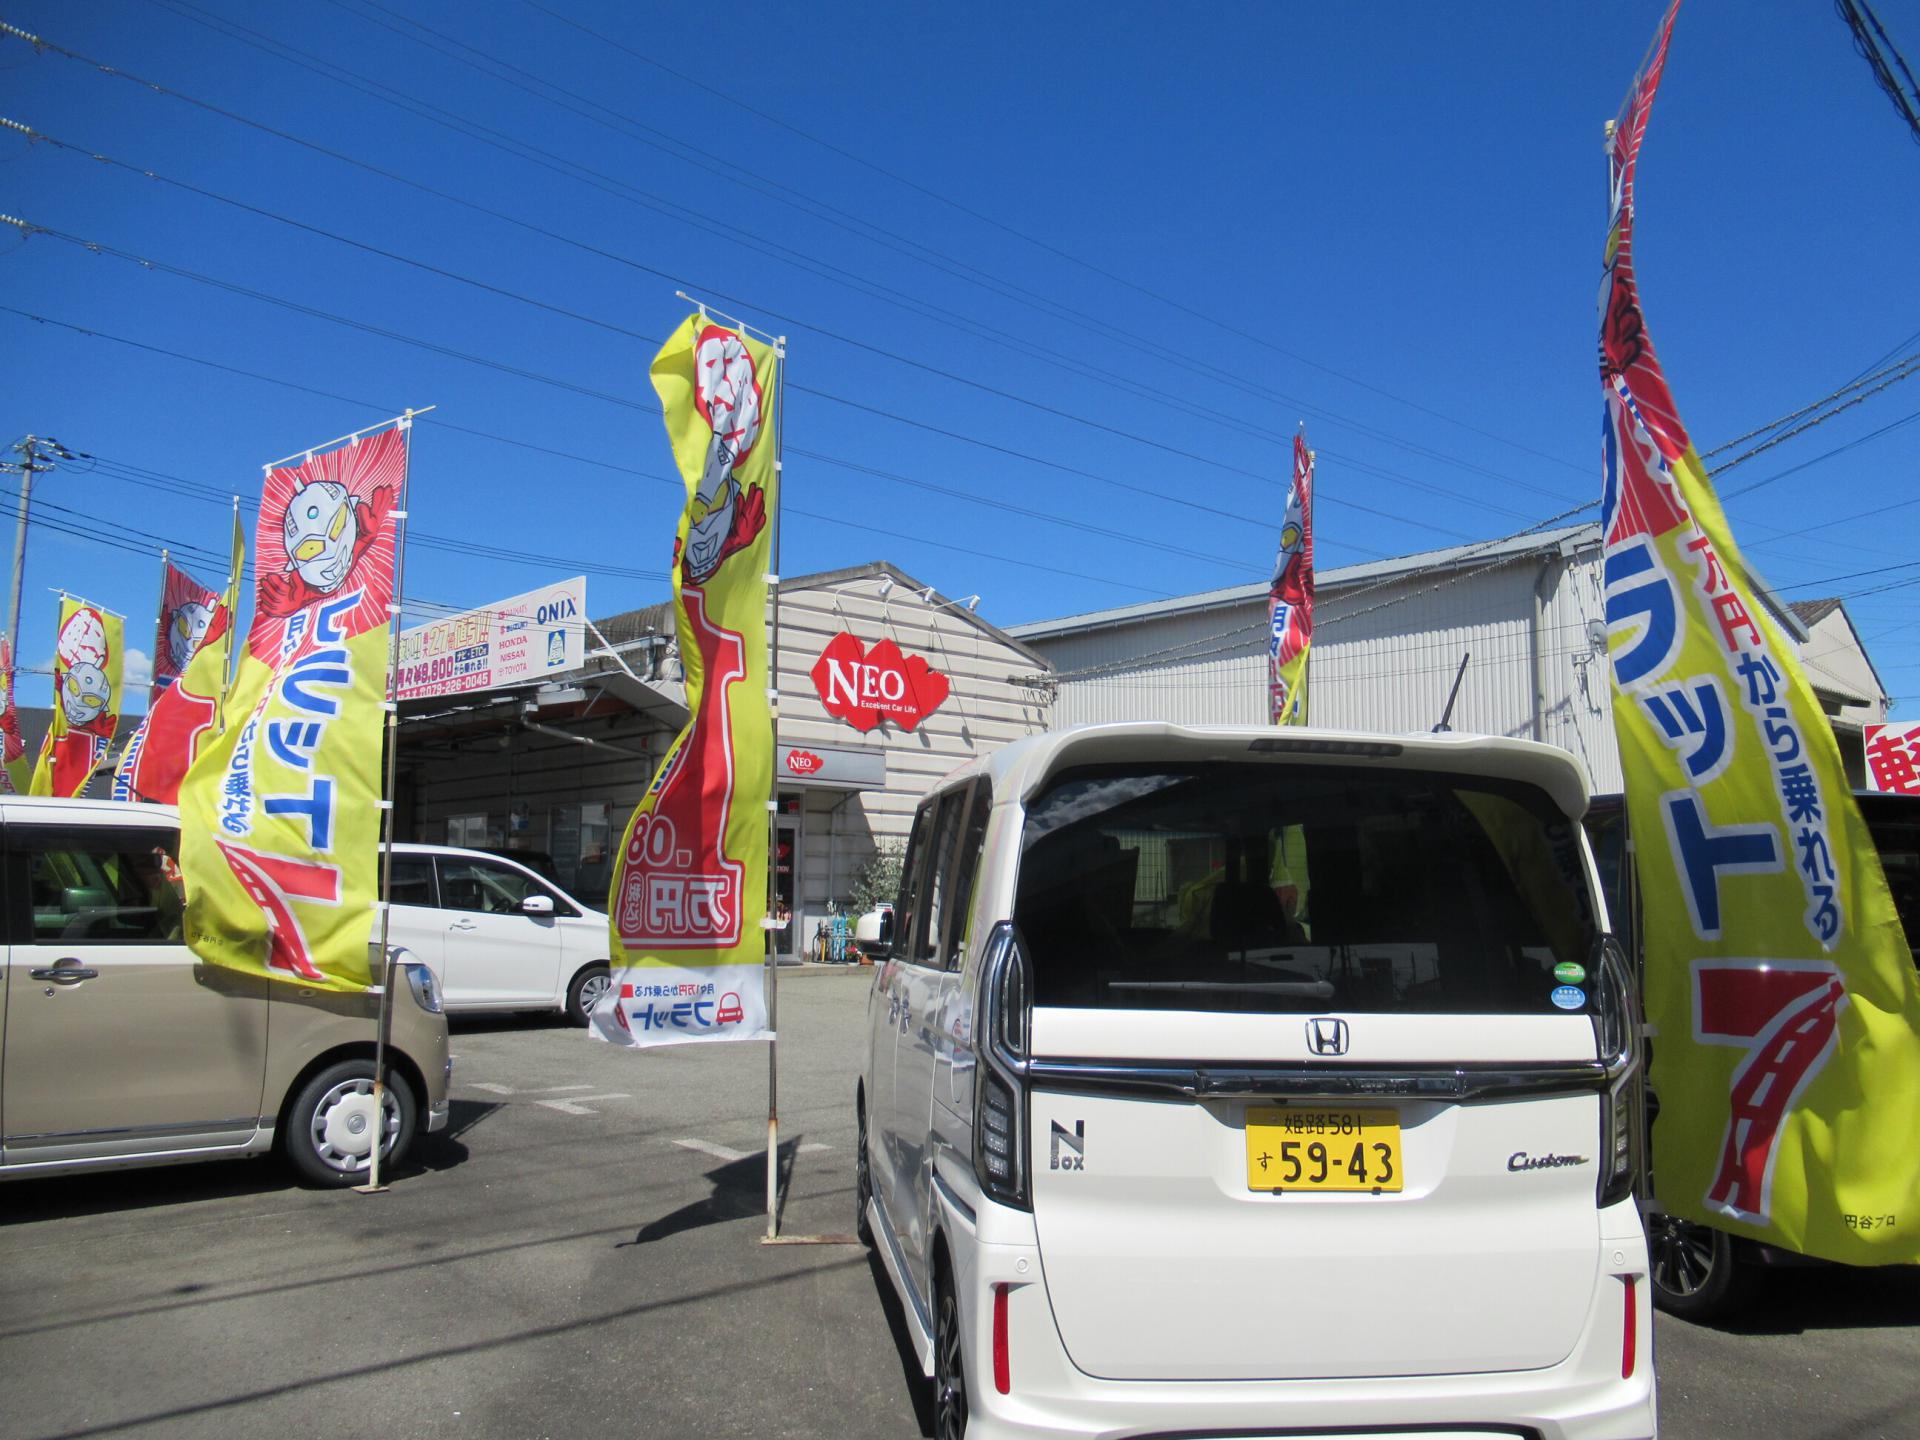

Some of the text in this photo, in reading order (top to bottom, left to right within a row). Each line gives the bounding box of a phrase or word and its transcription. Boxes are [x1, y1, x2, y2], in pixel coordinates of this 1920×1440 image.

[537, 598, 576, 625] ONIX
[499, 635, 528, 650] HONDA
[500, 649, 526, 663] NISSAN
[505, 662, 528, 675] TOYOTA
[827, 658, 905, 707] NEO
[861, 700, 917, 714] Excellent Car Life
[790, 756, 812, 769] NEO
[1050, 1156, 1084, 1170] BOX
[1257, 1142, 1393, 1184] す 59-43
[1507, 1152, 1589, 1172] Custom
